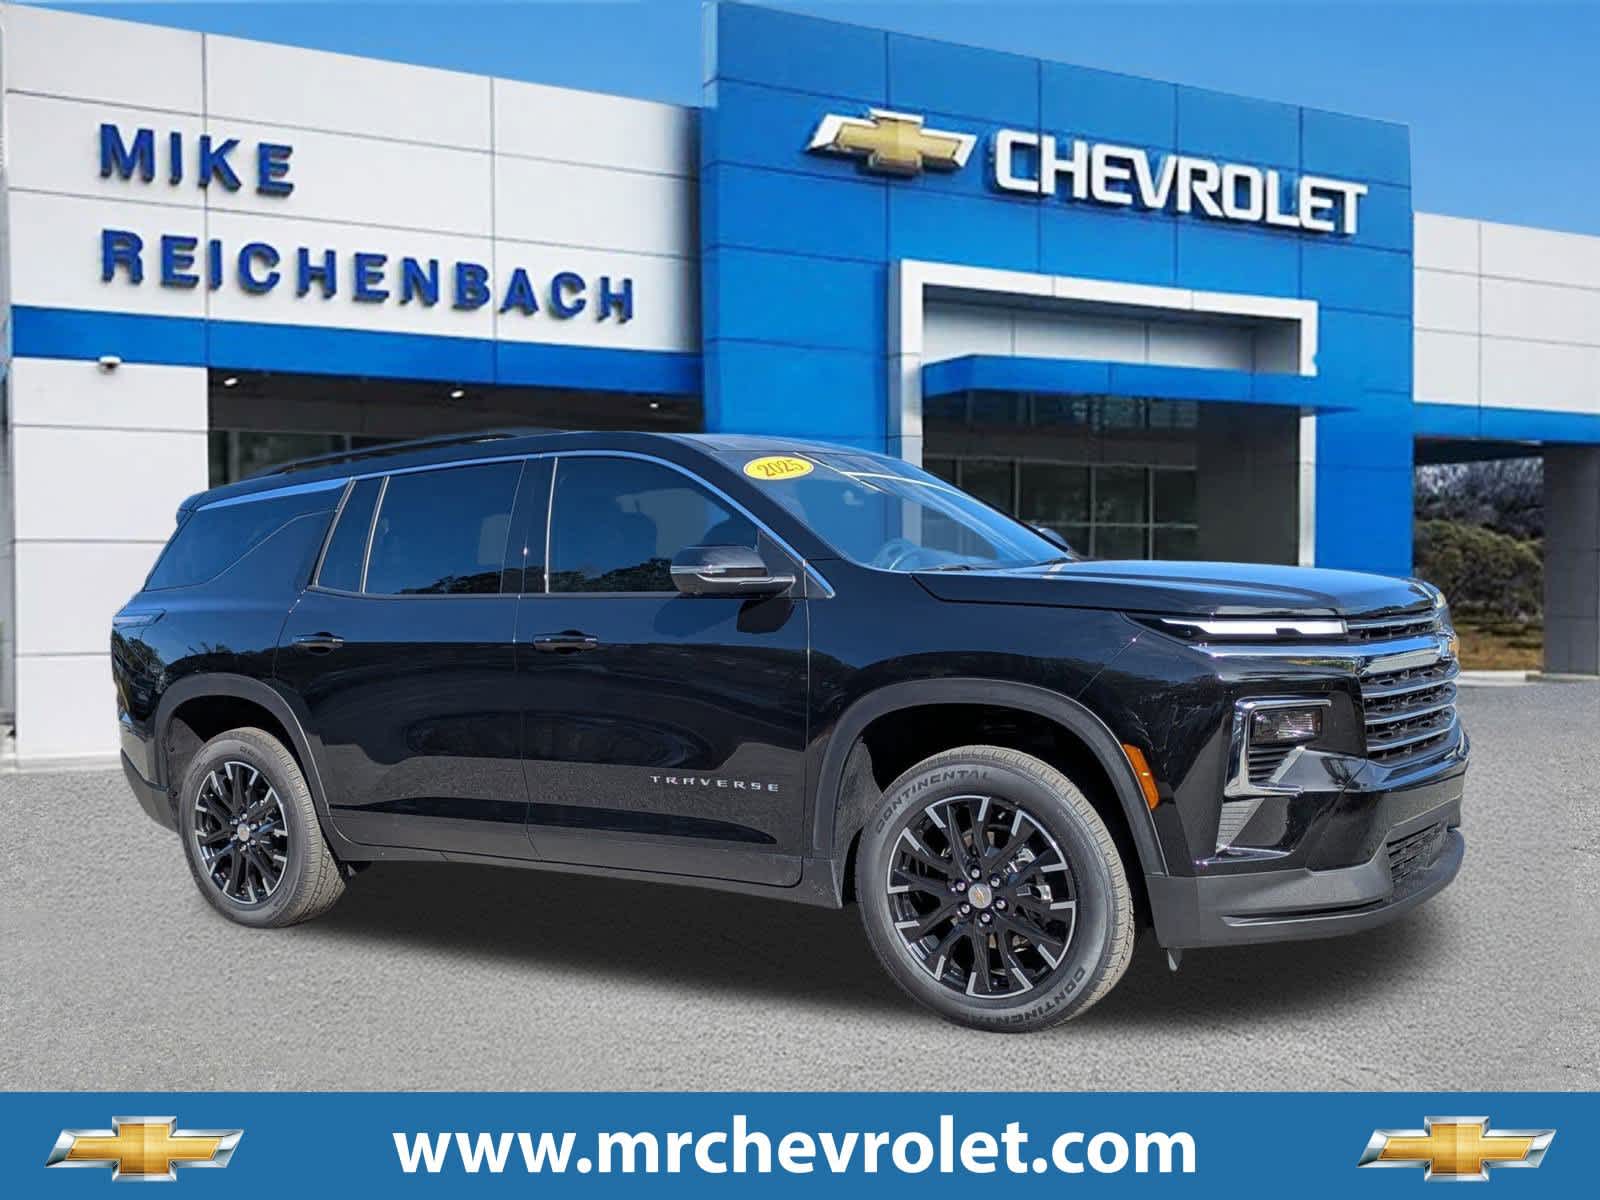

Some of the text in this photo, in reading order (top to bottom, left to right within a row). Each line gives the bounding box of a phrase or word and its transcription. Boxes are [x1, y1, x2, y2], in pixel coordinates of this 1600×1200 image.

[99, 122, 295, 197] MIKE
[994, 128, 1368, 235] CHEVROLET
[101, 229, 635, 322] REICHENBACH
[757, 459, 804, 476] 2025
[650, 775, 779, 792] TRAVERSE
[877, 769, 993, 833] CONTINENTAL
